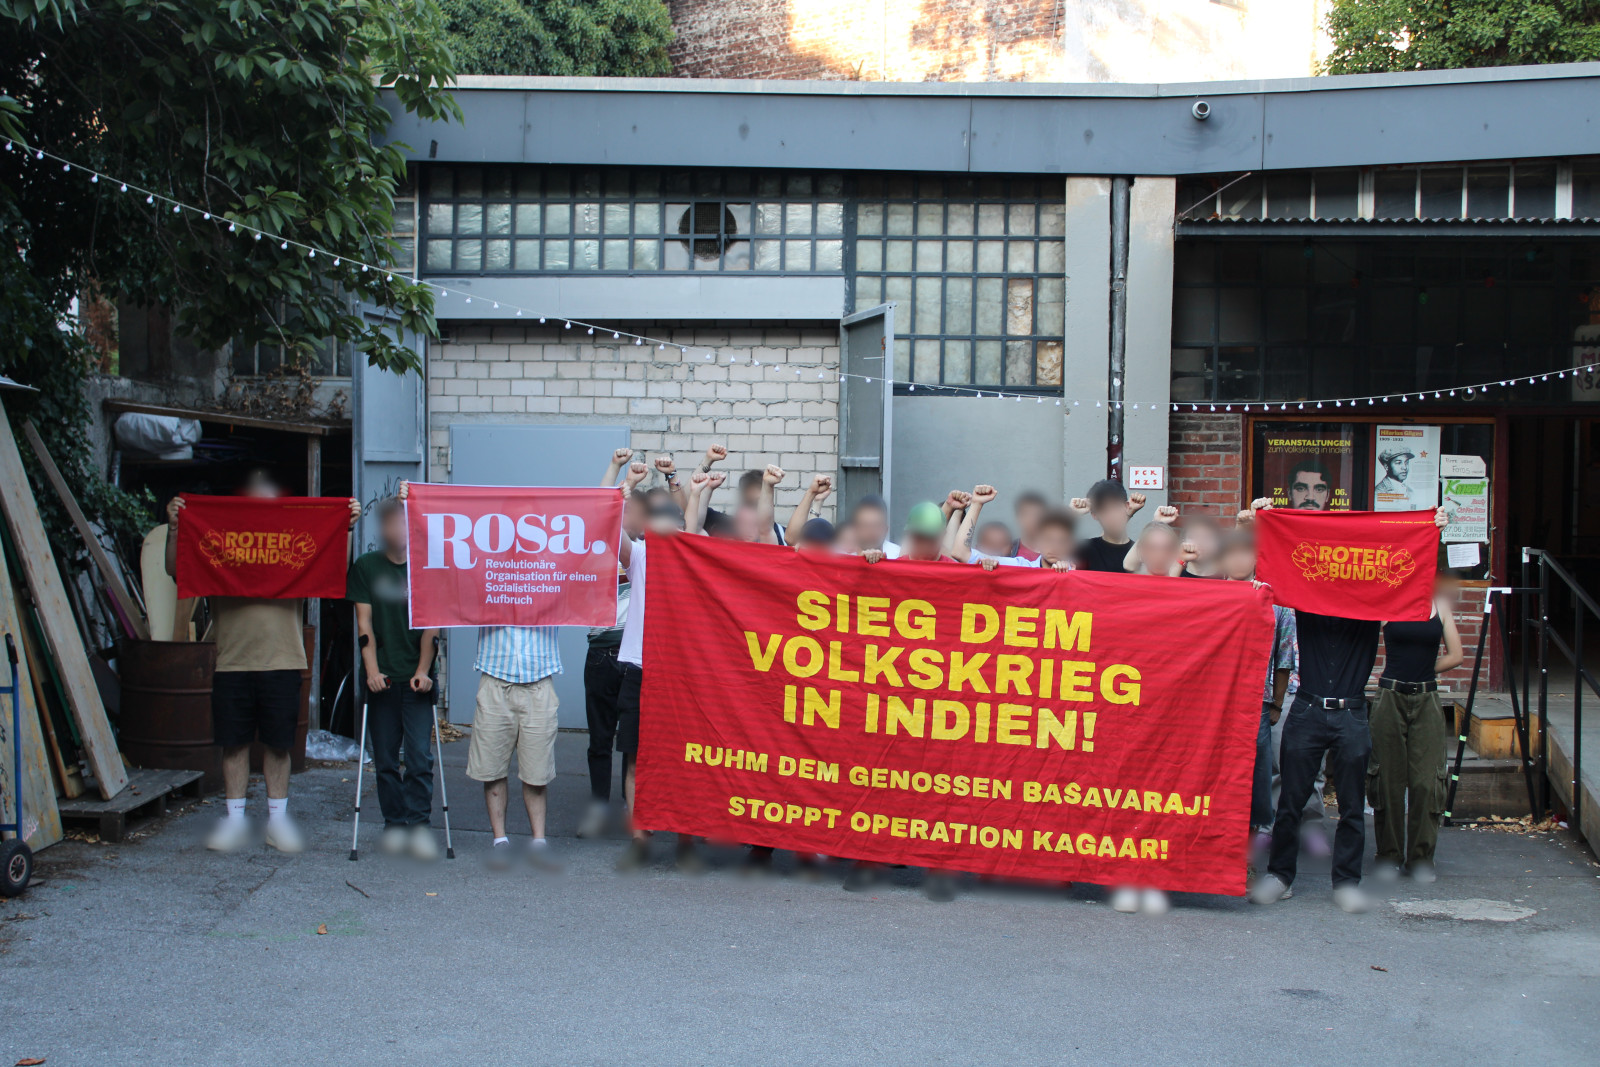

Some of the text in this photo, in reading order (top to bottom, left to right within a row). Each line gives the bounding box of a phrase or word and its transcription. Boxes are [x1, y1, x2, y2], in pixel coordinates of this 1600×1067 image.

[1268, 439, 1351, 447] VERANSTALTUNGEN
[1284, 446, 1320, 455] Volkskrieg
[1321, 446, 1328, 454] in
[1329, 446, 1351, 454] Indien
[1273, 487, 1285, 495] 27.
[1334, 488, 1348, 496] 06.
[1272, 497, 1289, 506] UNI
[1329, 498, 1350, 506] JULI
[225, 531, 291, 549] ROTER
[422, 513, 607, 570] Rosa.
[235, 547, 280, 564] BUND
[1319, 546, 1389, 566] ROTER
[485, 558, 557, 570] Revolutionäre
[485, 570, 598, 582] Organisation für einen
[1329, 562, 1377, 581] BUND
[485, 582, 561, 593] Sozialistischen
[485, 594, 533, 605] Aufbruch
[796, 590, 1094, 653] SIEG DEM
[743, 630, 1142, 707] VOLKSKRIEG
[783, 684, 1098, 753] IN INDIEN!
[684, 742, 1211, 816] RUHM DEM GENOSSEN BASAVARAJ!
[727, 795, 1169, 860] STOPPT OPERATION KAGAAR!
